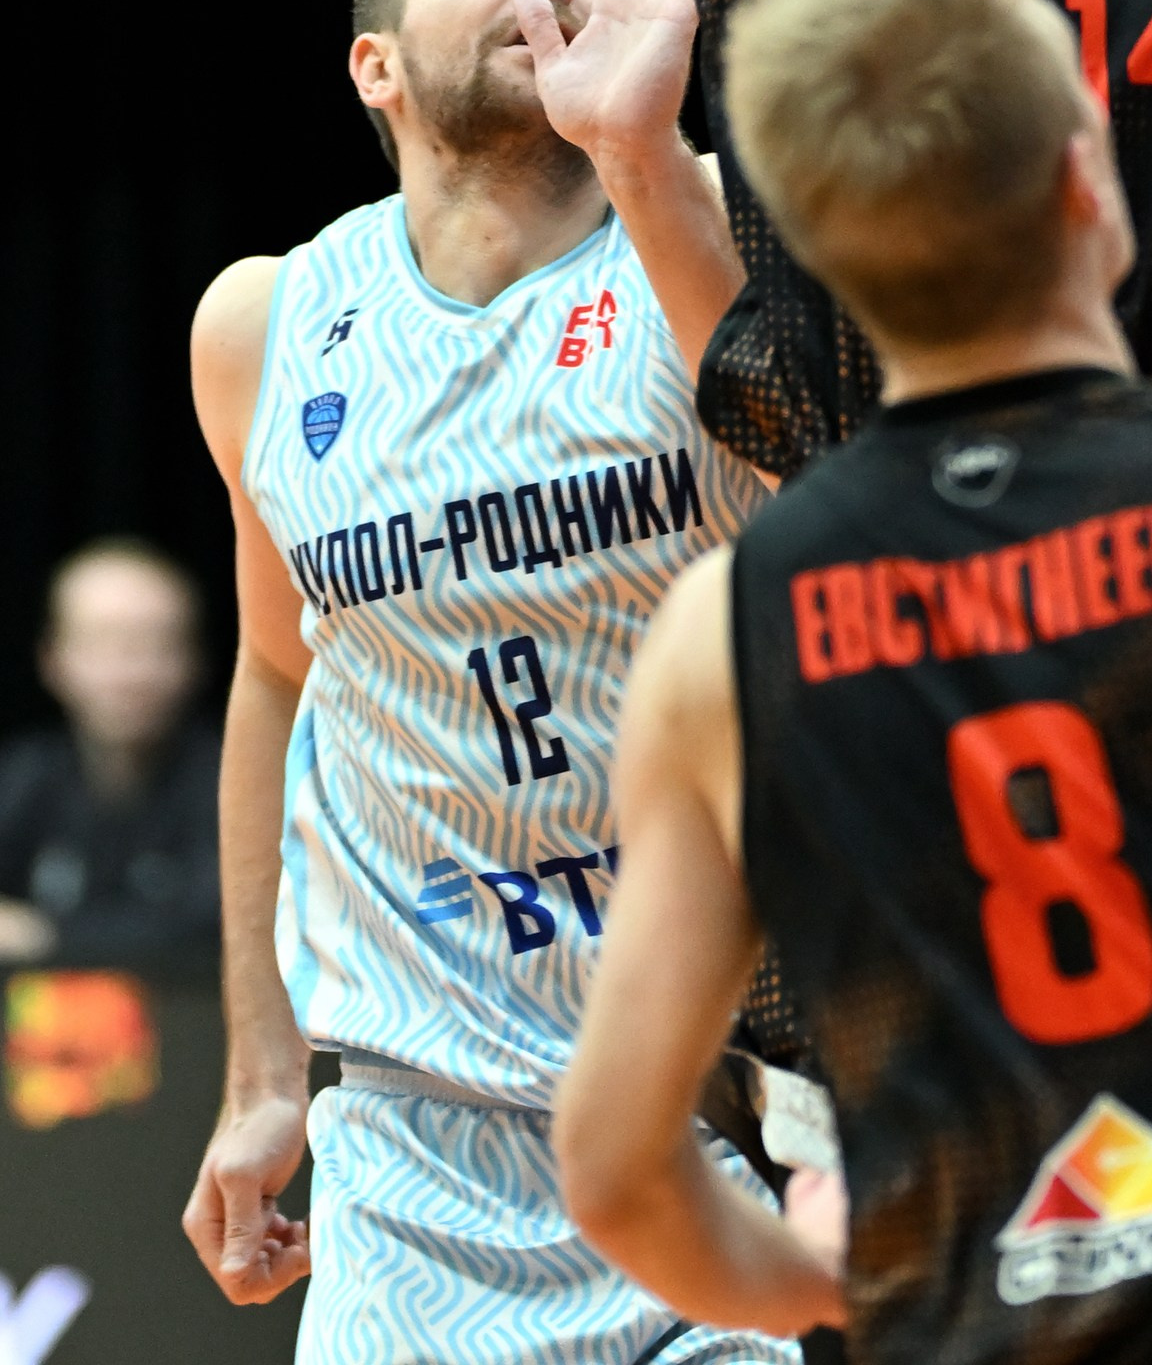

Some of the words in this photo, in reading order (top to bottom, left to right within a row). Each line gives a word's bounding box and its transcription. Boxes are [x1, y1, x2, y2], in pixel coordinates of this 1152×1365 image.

[290, 447, 704, 619] КУПОЛ-РОДНИКИ
[466, 635, 572, 787] 12
[477, 846, 620, 956] ВТ
